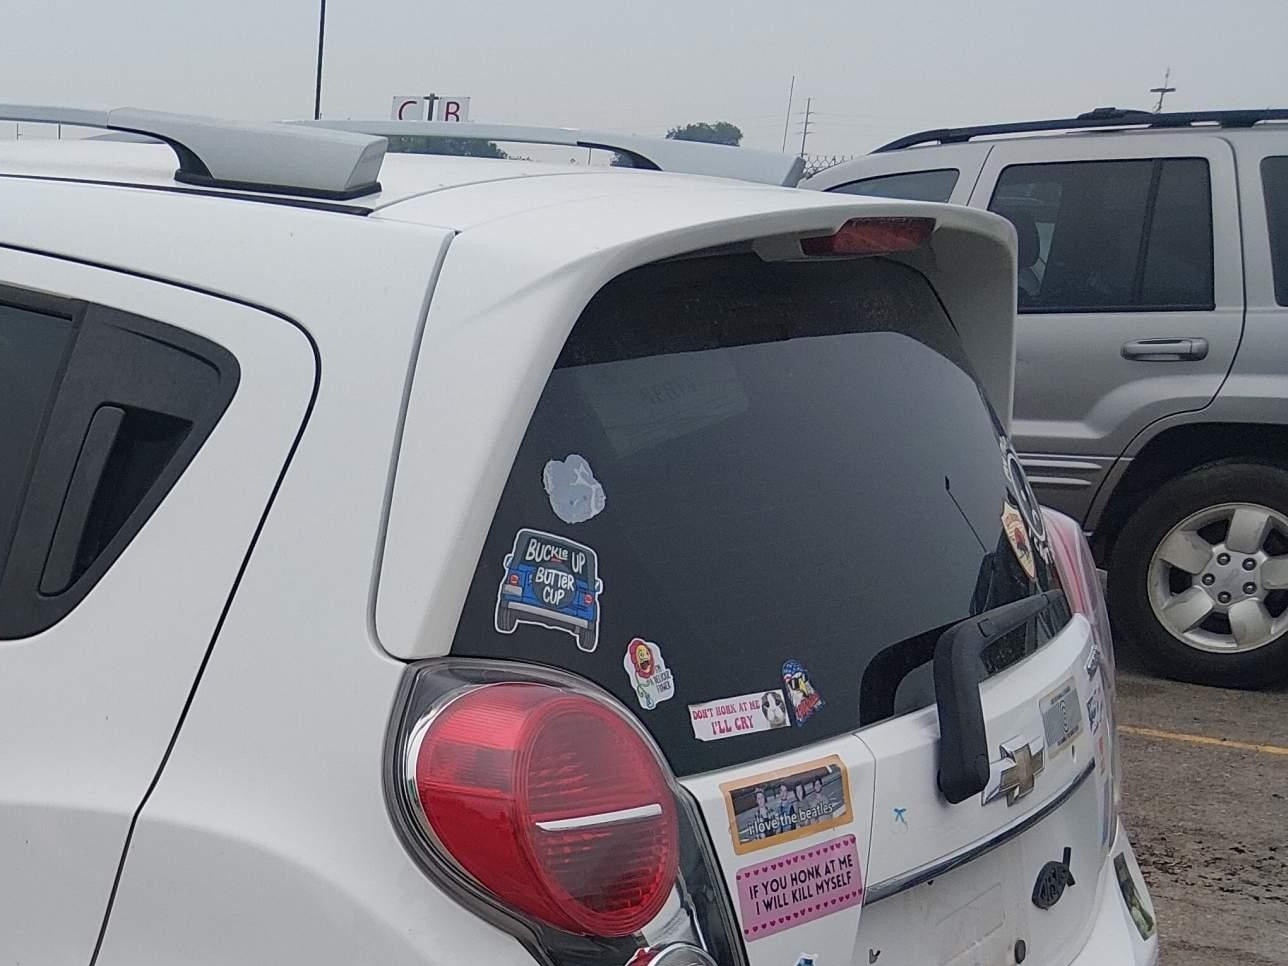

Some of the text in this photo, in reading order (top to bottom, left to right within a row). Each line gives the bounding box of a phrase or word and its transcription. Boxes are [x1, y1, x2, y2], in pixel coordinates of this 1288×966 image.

[571, 552, 586, 574] UP
[542, 586, 565, 605] CUP
[693, 699, 761, 720] DON'T HONK AT ME
[711, 715, 754, 735] I'LL CRY
[754, 818, 778, 834] love
[780, 812, 798, 826] the
[798, 801, 833, 821] beatles
[749, 854, 853, 900] IF YOU HONK AT ME
[755, 871, 852, 915] I WILL KILL MYSELF
